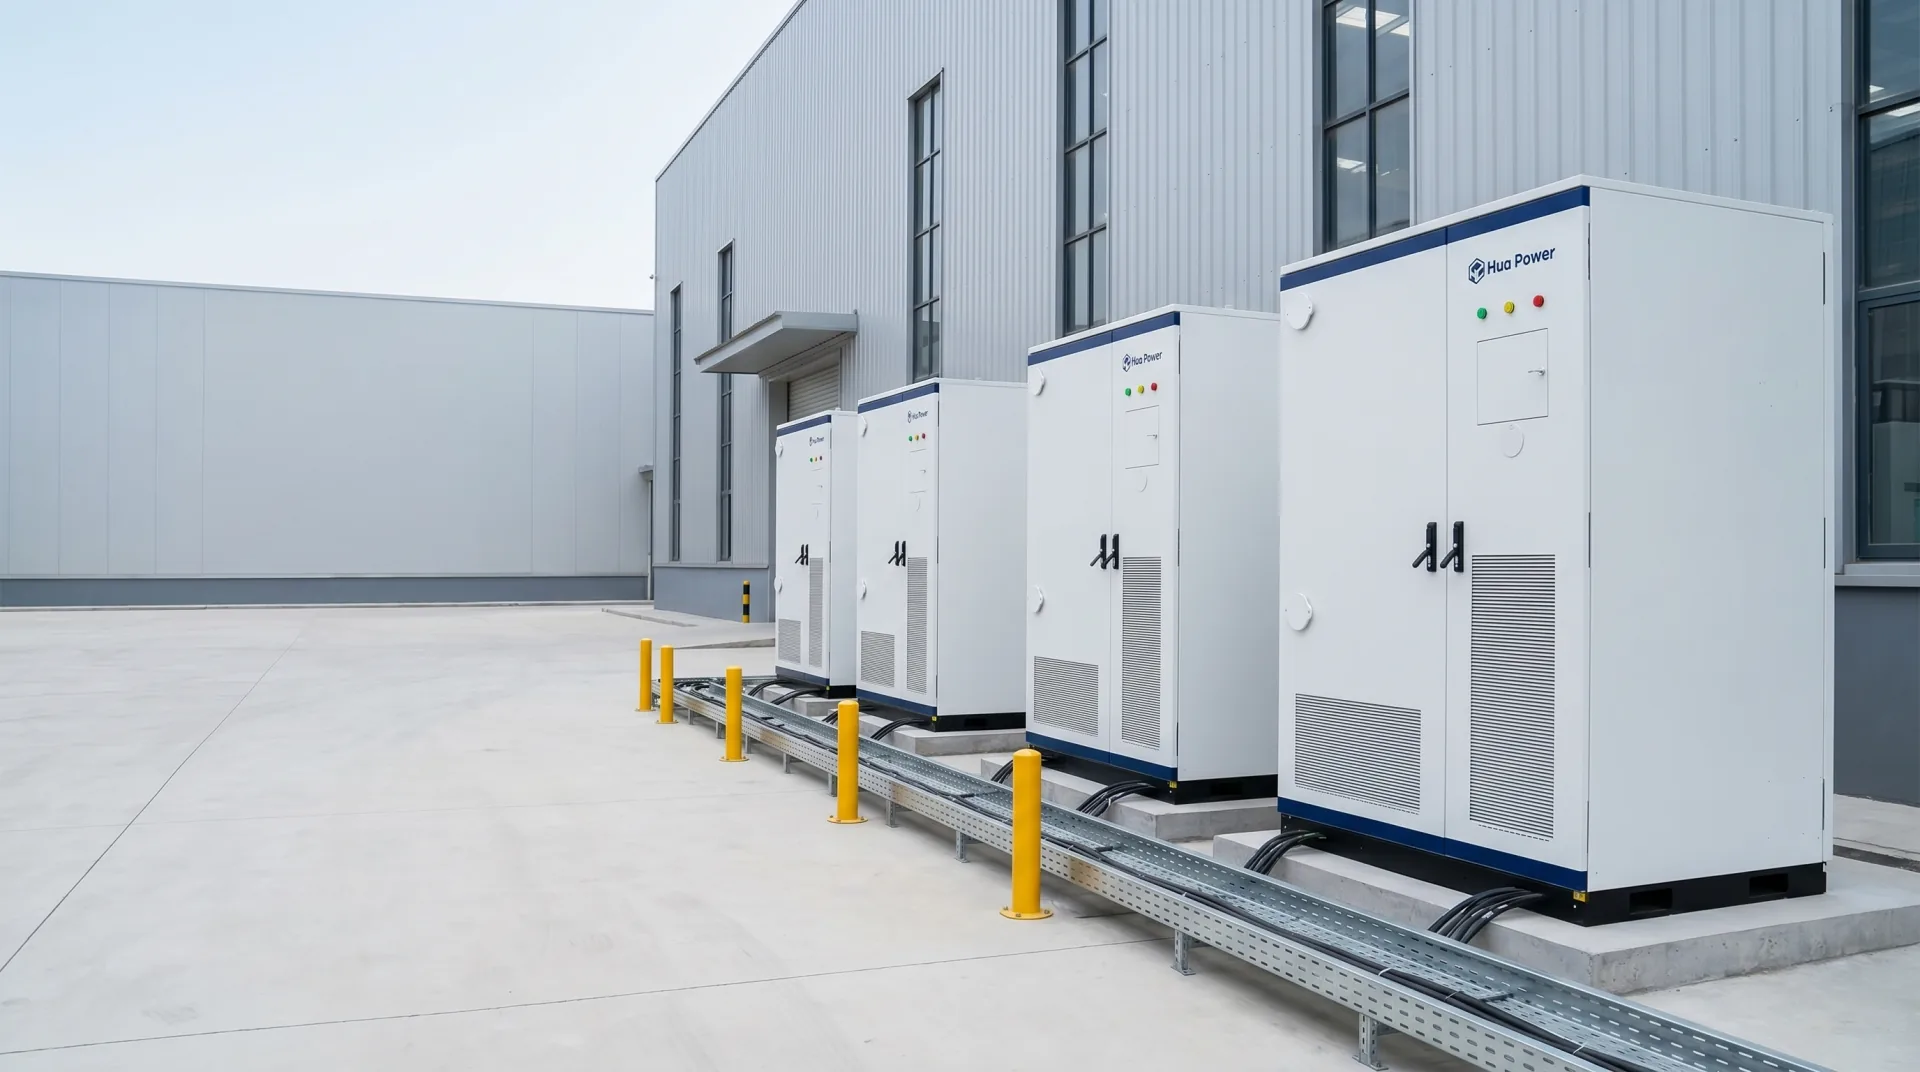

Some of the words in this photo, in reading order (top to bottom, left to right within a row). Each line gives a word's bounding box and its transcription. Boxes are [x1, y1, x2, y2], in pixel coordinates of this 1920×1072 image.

[1487, 260, 1511, 274] Hua
[1514, 247, 1556, 268] Power
[1143, 351, 1163, 363] Power
